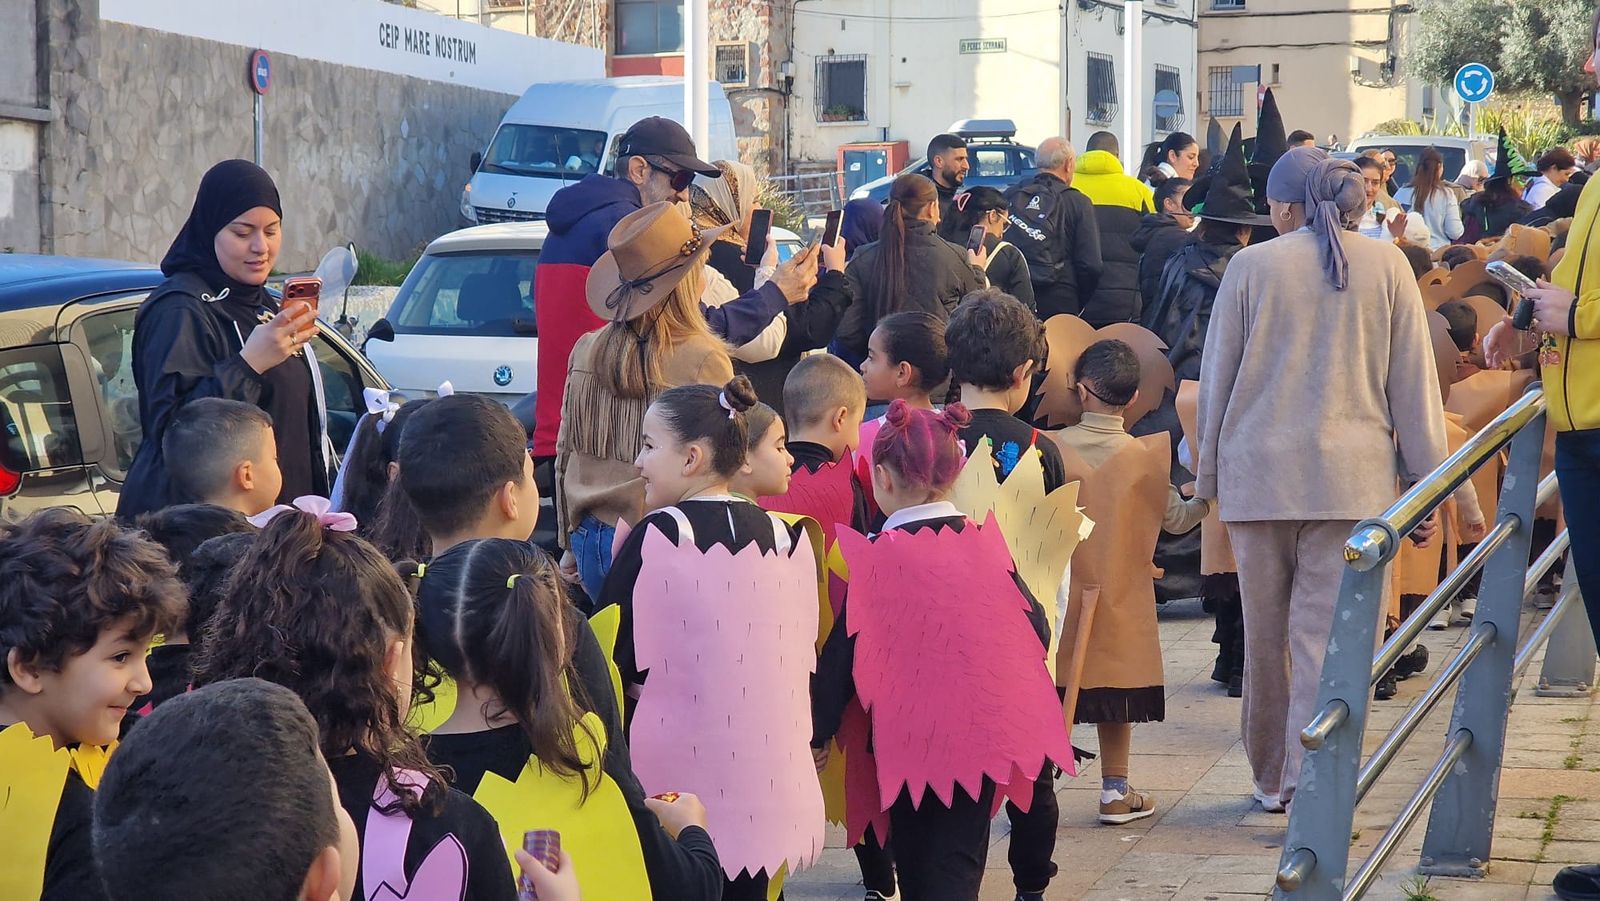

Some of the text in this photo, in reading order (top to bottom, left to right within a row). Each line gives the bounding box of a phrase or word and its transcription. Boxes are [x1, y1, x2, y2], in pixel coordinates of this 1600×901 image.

[379, 22, 477, 65] CEIP MARE NOSTRUM
